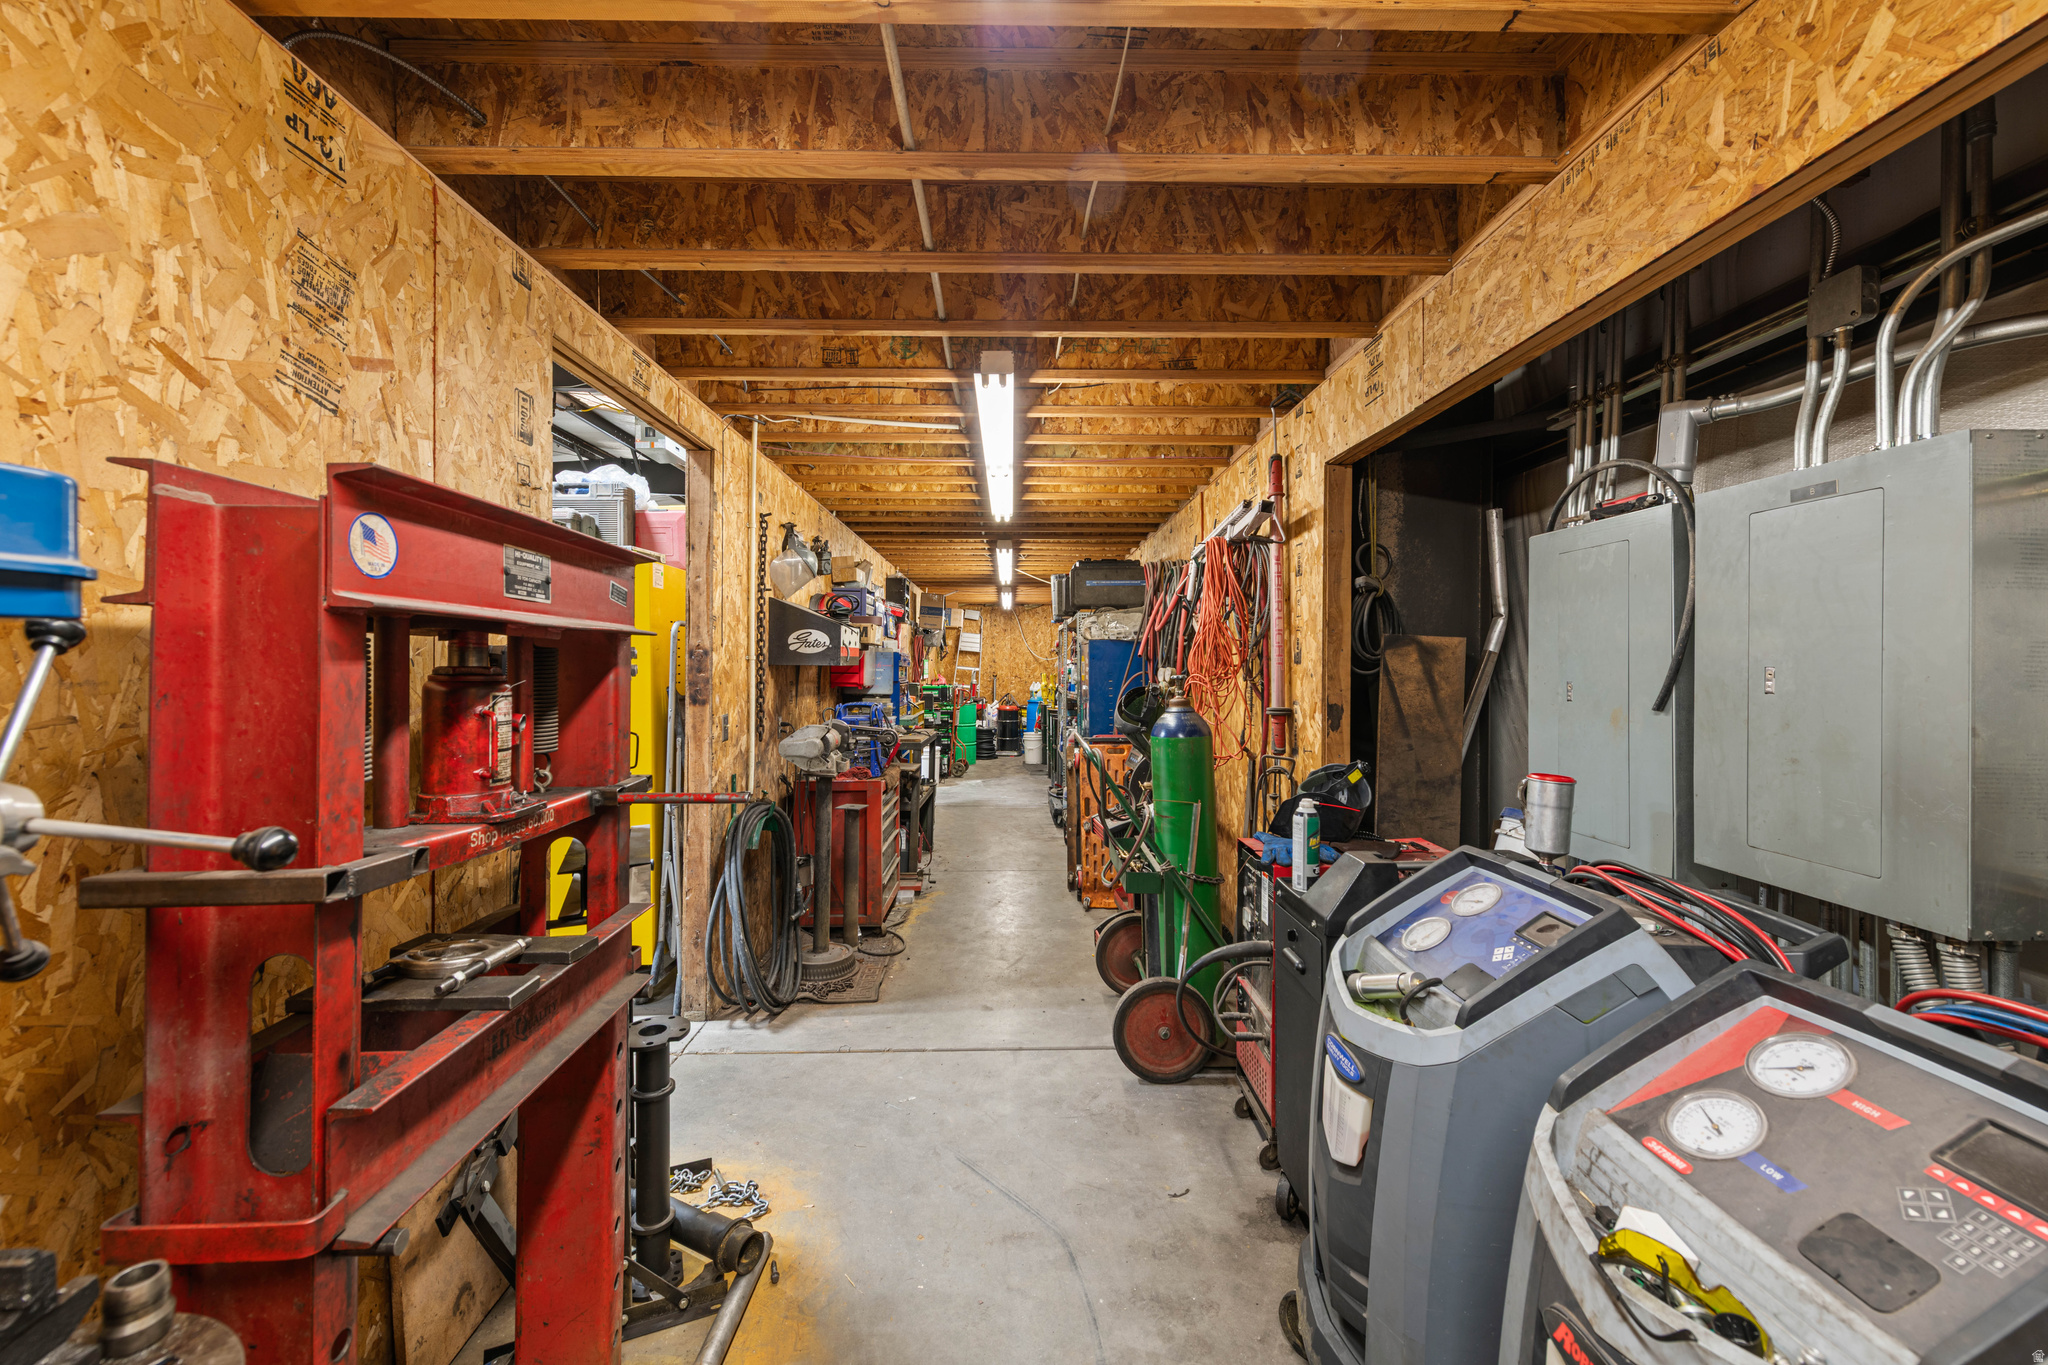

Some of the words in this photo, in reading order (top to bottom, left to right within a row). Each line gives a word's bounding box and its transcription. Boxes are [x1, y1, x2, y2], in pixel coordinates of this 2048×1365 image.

[291, 57, 337, 110] APA
[284, 112, 310, 142] LP
[515, 550, 543, 563] HI-QUALITY
[788, 631, 828, 651] Gates
[1274, 617, 1284, 671] LIGHT
[470, 830, 498, 848] Shop
[501, 821, 526, 837] Press
[528, 809, 555, 829] 60,000
[1327, 1037, 1355, 1072] CORNWELL
[1327, 1043, 1339, 1061] QUALITY
[1340, 1060, 1354, 1077] TOOLS
[1851, 1100, 1882, 1118] HIGH
[1759, 1163, 1784, 1181] LOW
[1552, 1321, 1595, 1365] ROB
